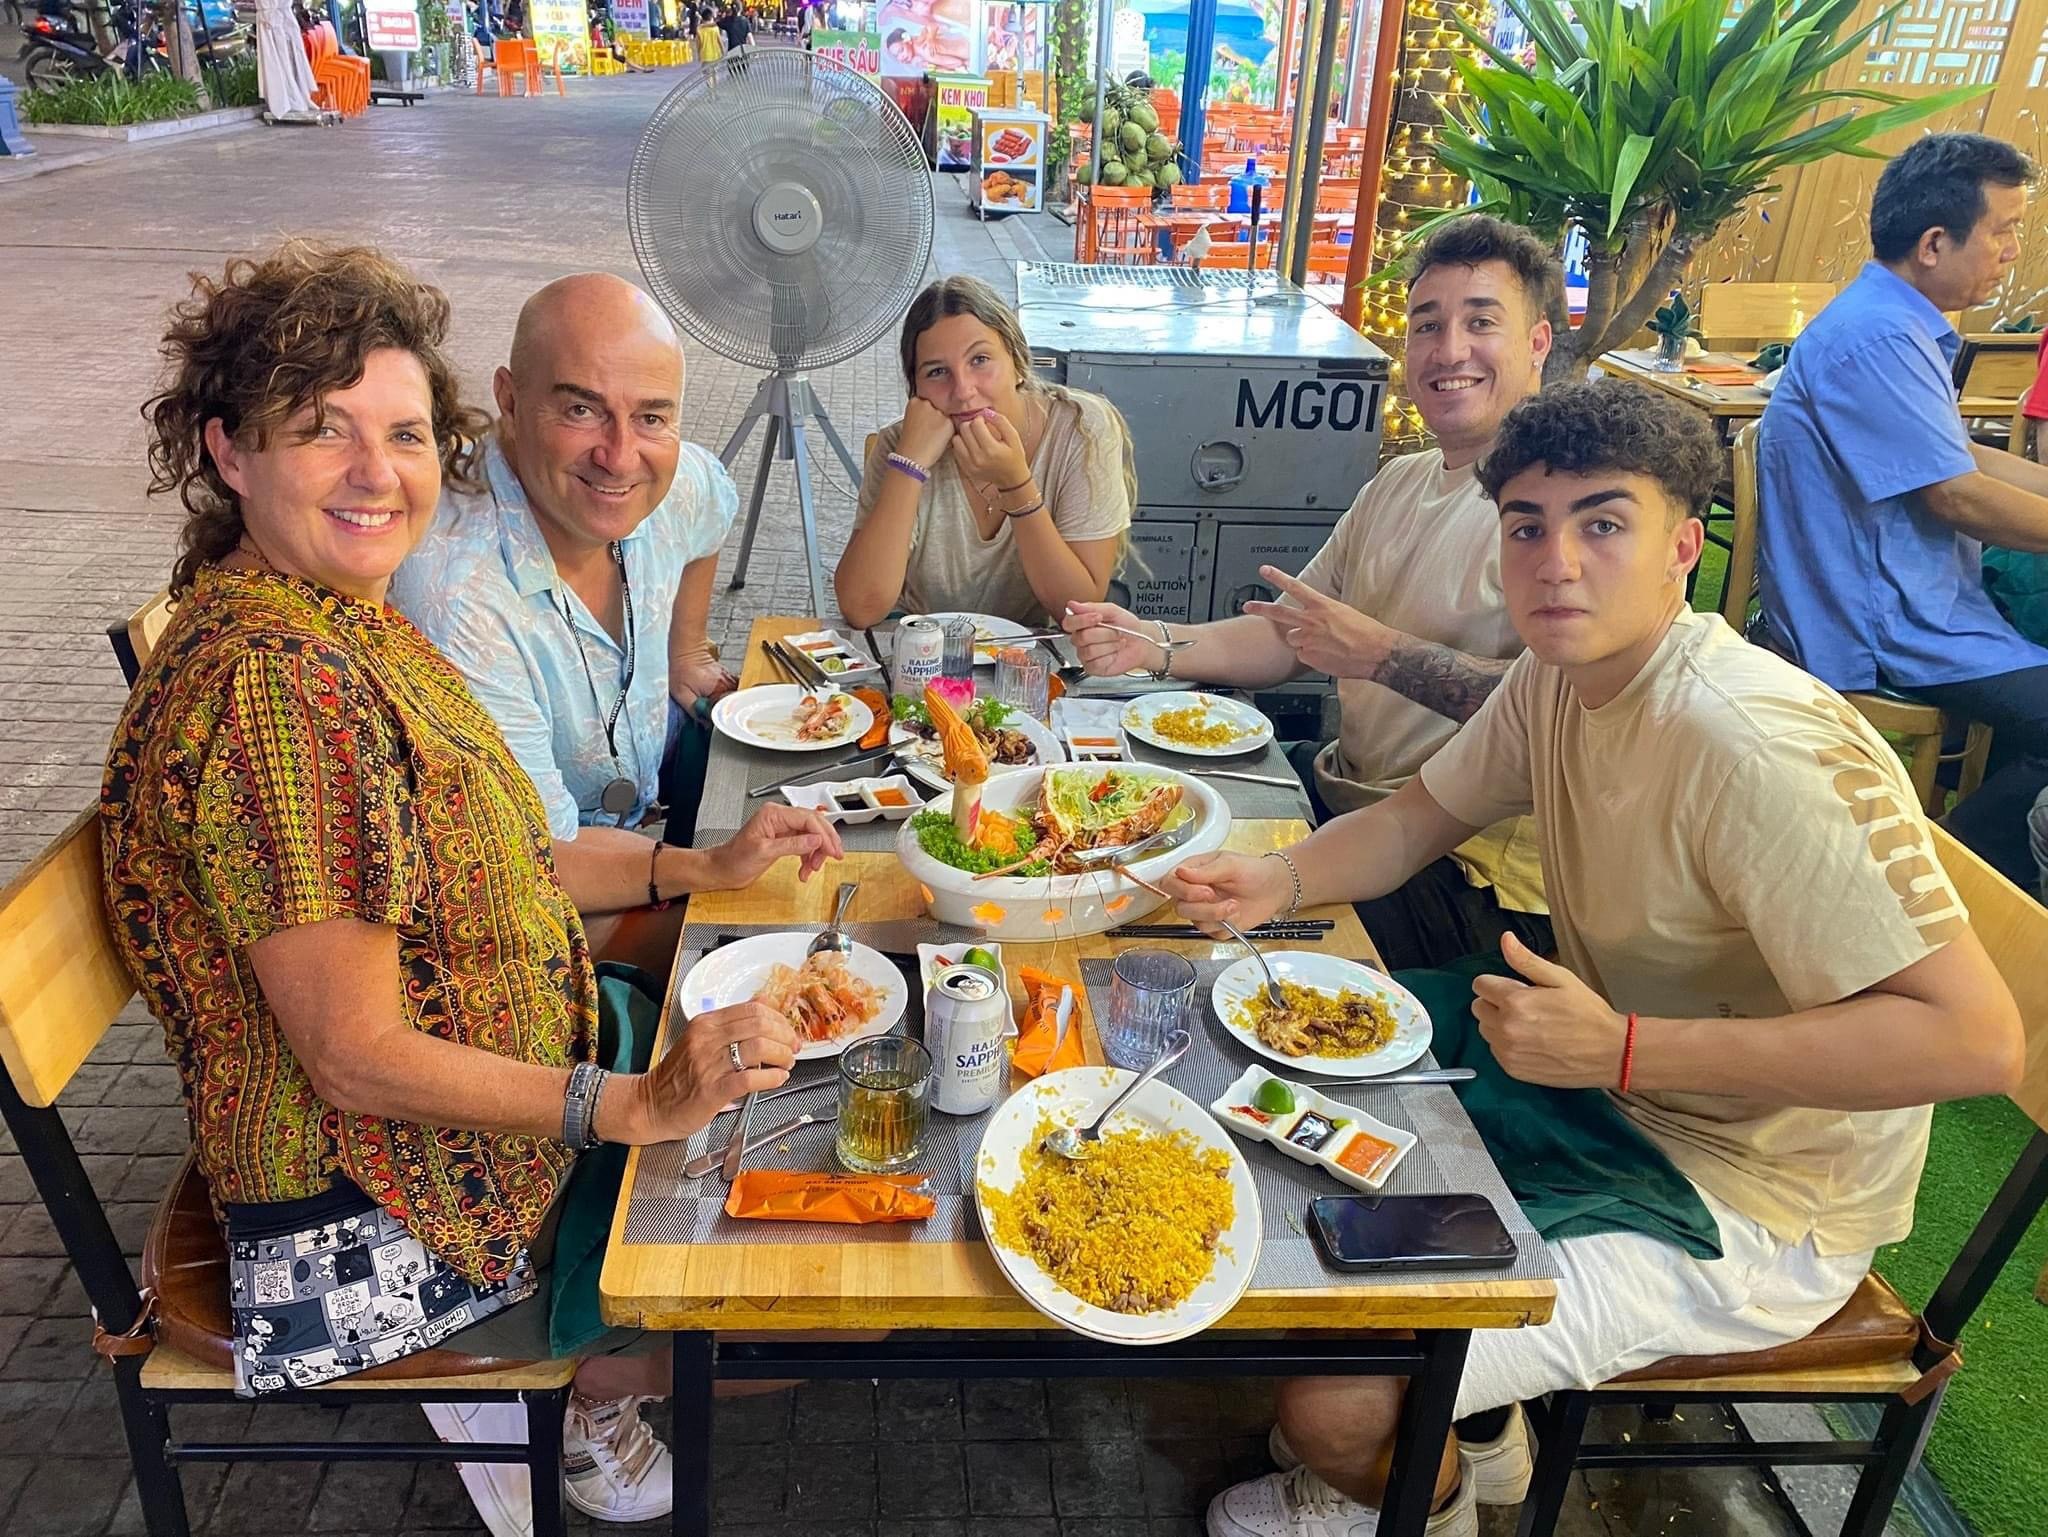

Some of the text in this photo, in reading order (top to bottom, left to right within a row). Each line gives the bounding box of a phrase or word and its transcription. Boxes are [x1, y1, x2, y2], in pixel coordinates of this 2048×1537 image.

[941, 87, 961, 106] KEM
[774, 210, 802, 221] Hatari
[1250, 545, 1309, 554] STORAGE BOX
[1137, 580, 1187, 590] CAUTION
[1136, 593, 1164, 603] HIGH
[1135, 605, 1187, 616] VOLTAGE
